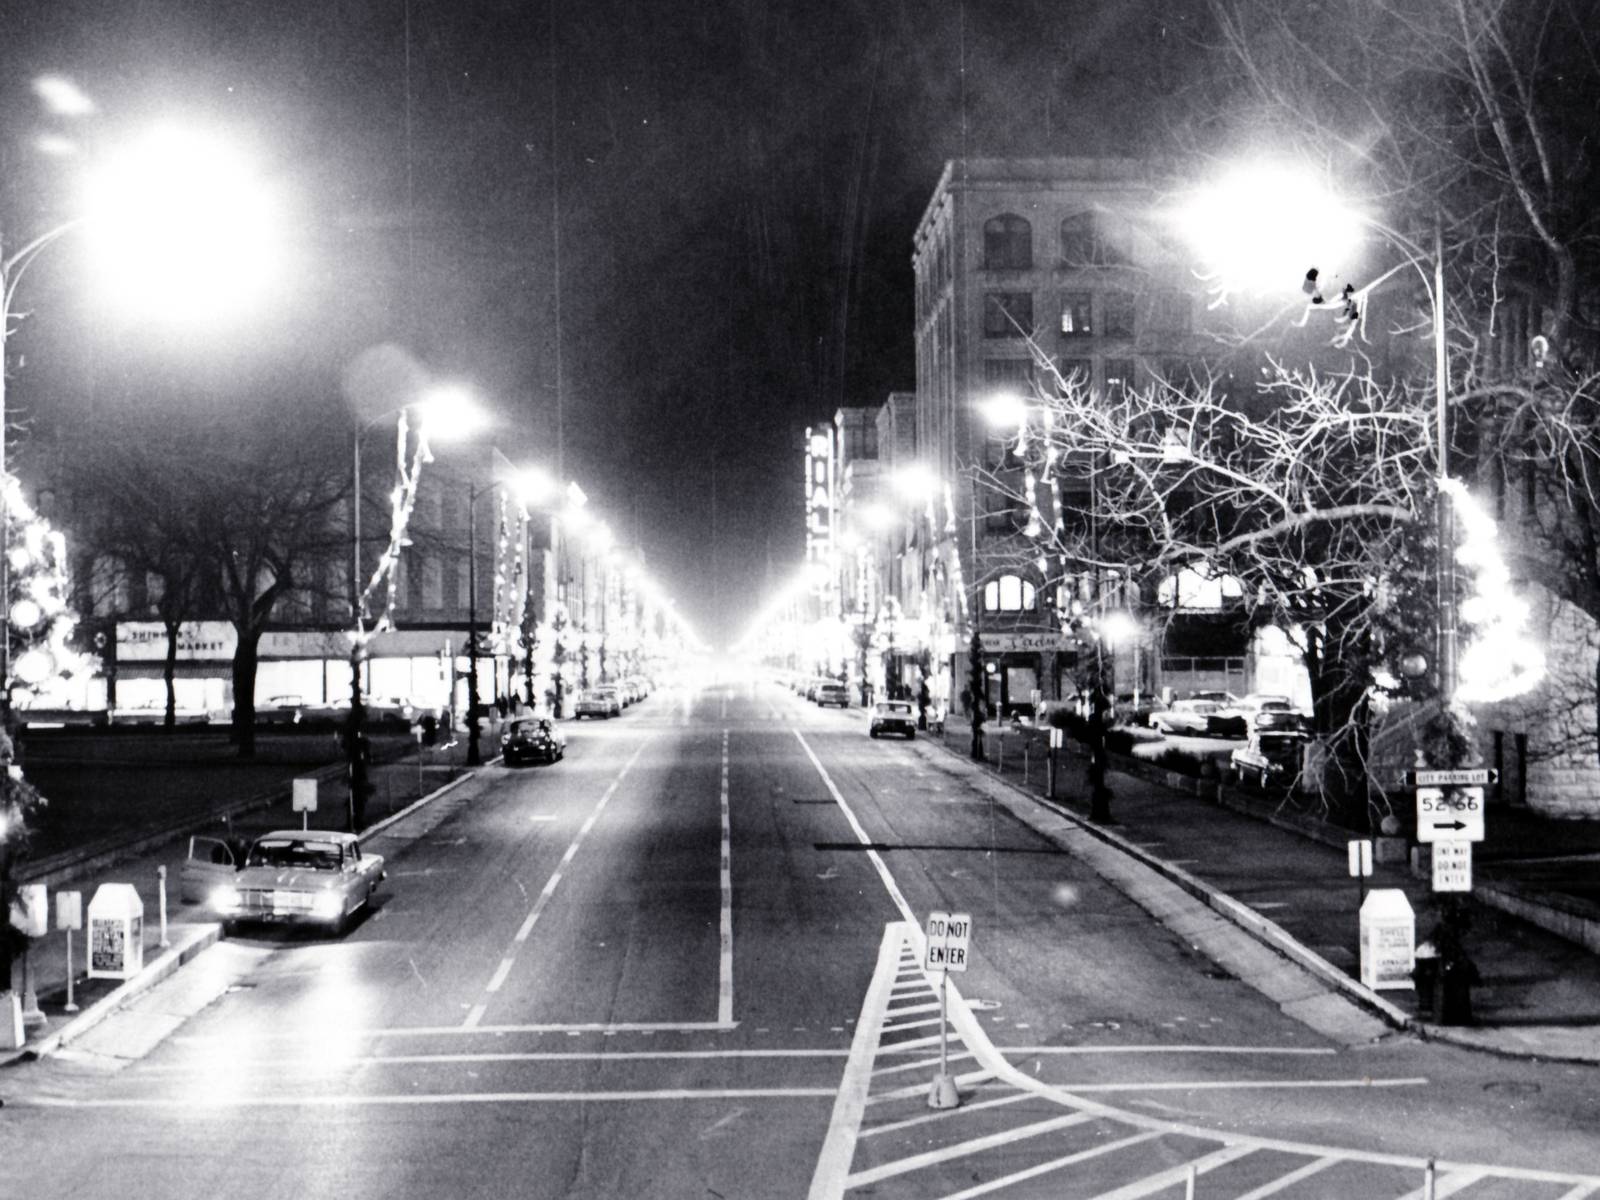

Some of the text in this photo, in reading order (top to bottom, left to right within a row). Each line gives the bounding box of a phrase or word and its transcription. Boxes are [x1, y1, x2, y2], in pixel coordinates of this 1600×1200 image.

[810, 434, 830, 588] RIALT
[177, 642, 223, 651] MARKET
[1439, 773, 1469, 782] PARKING
[1472, 773, 1485, 781] LOT
[930, 920, 968, 938] DO NOT
[930, 946, 965, 964] ENTER
